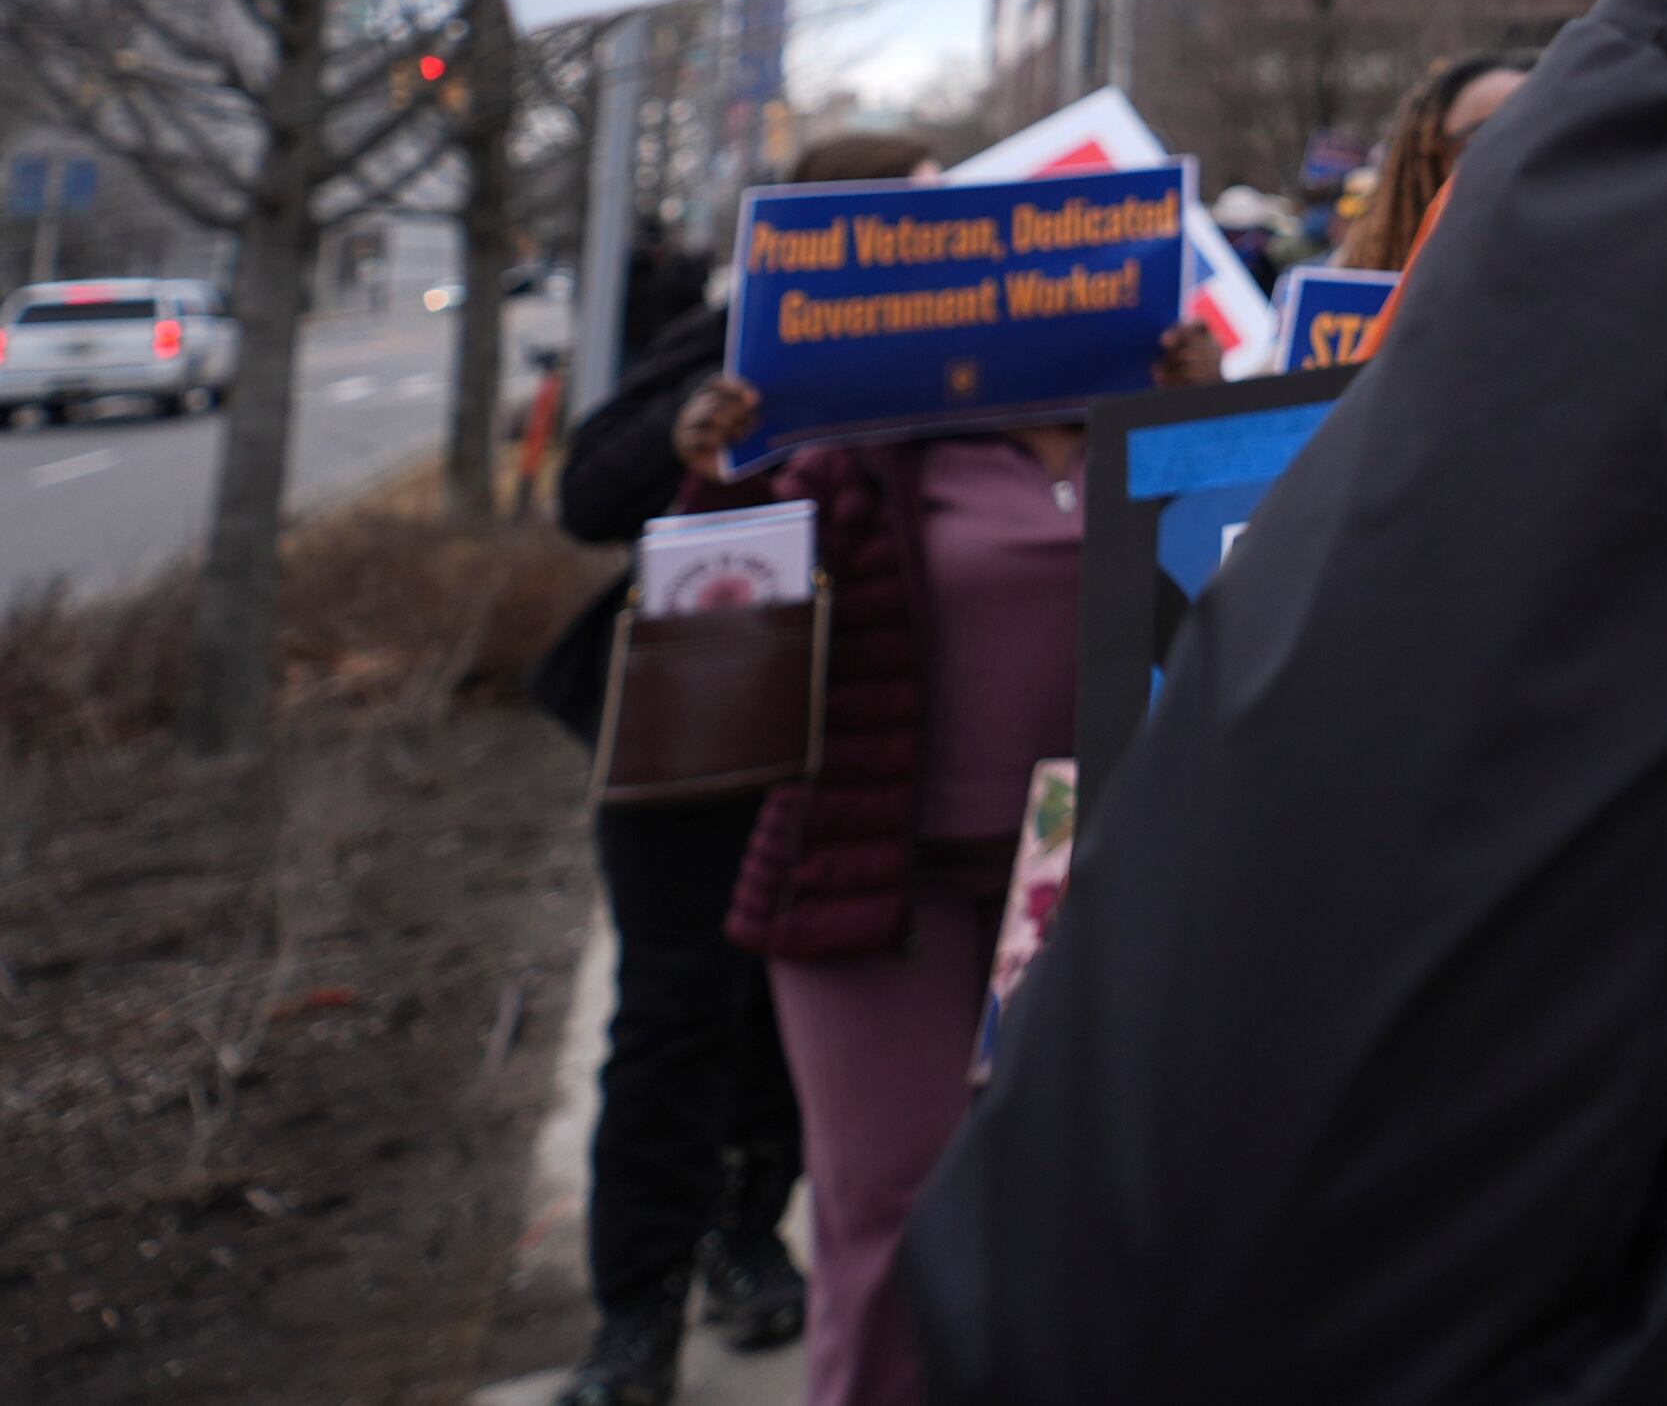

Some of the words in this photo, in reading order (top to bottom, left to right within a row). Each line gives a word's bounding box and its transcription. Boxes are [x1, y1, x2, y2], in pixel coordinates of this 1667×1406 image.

[749, 219, 846, 274] Proud
[854, 213, 1008, 268] Veteran,
[1011, 188, 1179, 255] Dedicated
[779, 277, 998, 344] Government
[1004, 258, 1140, 320] Worker!
